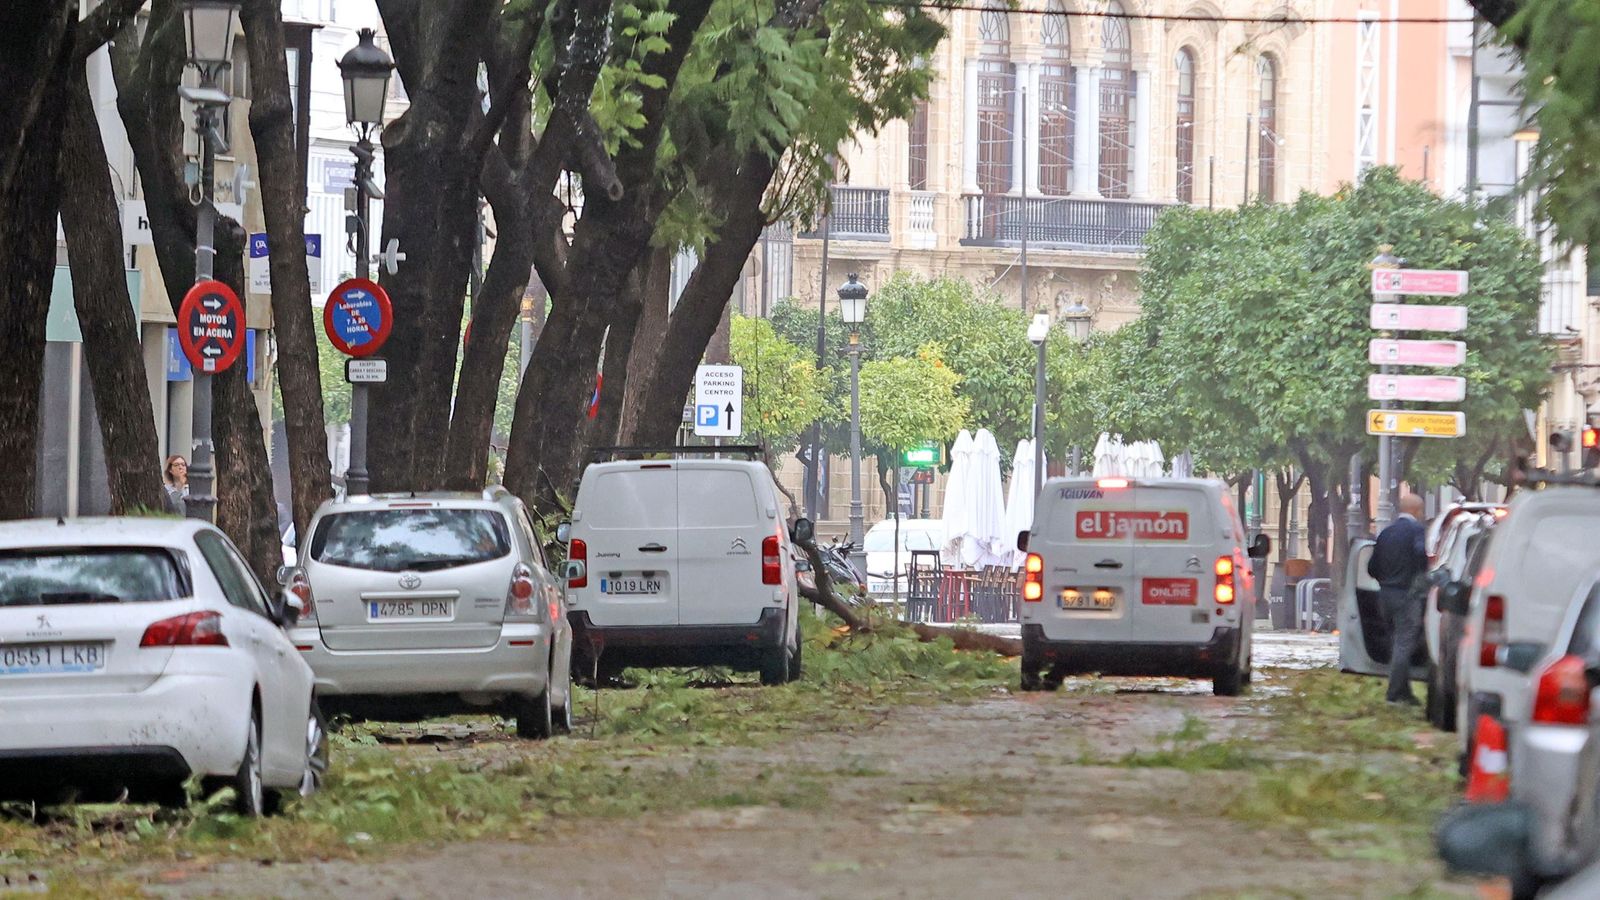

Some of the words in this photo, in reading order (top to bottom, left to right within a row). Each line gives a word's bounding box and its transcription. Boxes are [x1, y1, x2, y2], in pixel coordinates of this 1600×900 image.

[339, 301, 372, 310] Laborables
[199, 313, 228, 325] MOTOS
[351, 309, 360, 317] DE
[193, 326, 205, 336] EN
[206, 328, 232, 339] ACERA
[346, 324, 369, 333] HORAS
[700, 407, 716, 425] P
[1080, 513, 1103, 533] el
[1106, 511, 1184, 537] jamón
[609, 581, 636, 592] 1019
[639, 581, 661, 592] LRN
[1150, 587, 1191, 598] ONLINE
[380, 602, 415, 616] 4785
[421, 602, 448, 616] DPN
[4, 647, 51, 667] 0551
[61, 645, 98, 664] LKB
